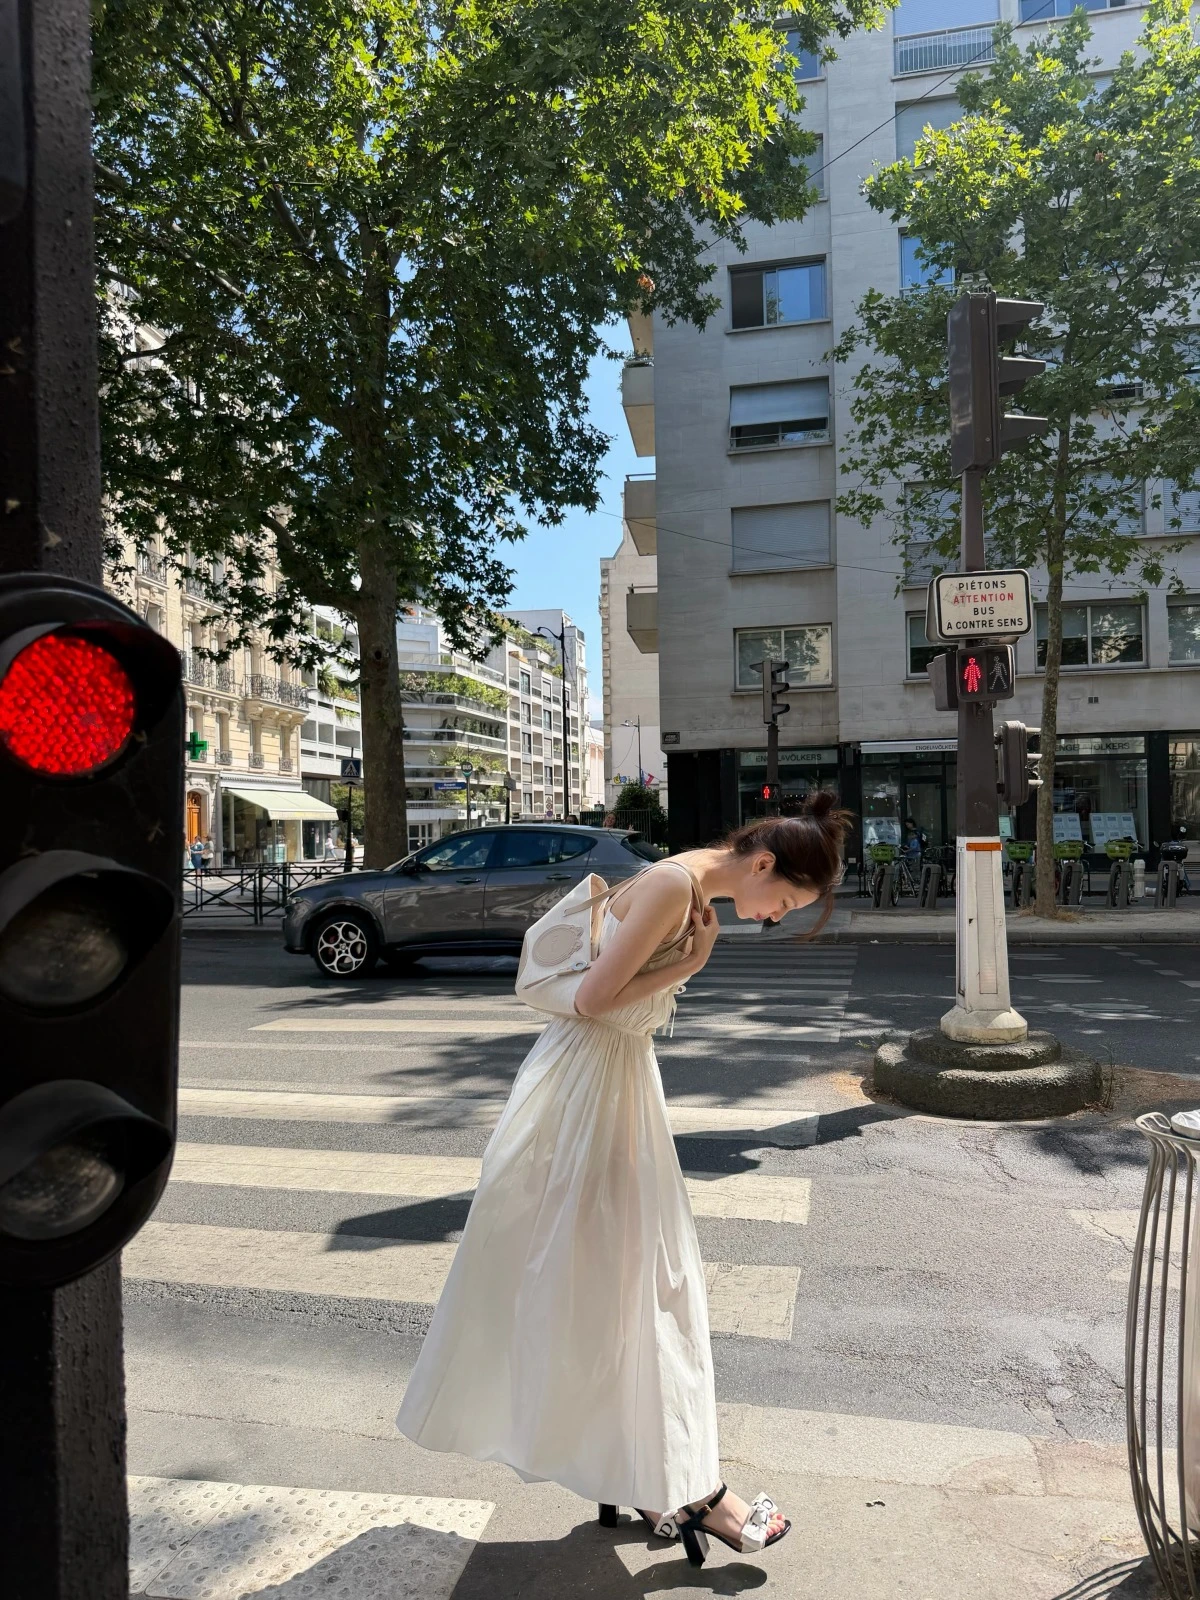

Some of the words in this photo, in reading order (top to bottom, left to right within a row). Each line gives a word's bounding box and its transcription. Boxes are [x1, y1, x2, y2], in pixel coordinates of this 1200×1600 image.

[958, 580, 1006, 591] PIÉTONS
[953, 593, 1013, 604] ATTENTION
[973, 606, 995, 616] BUS
[955, 619, 995, 629] CONTRE
[997, 617, 1024, 627] SENS
